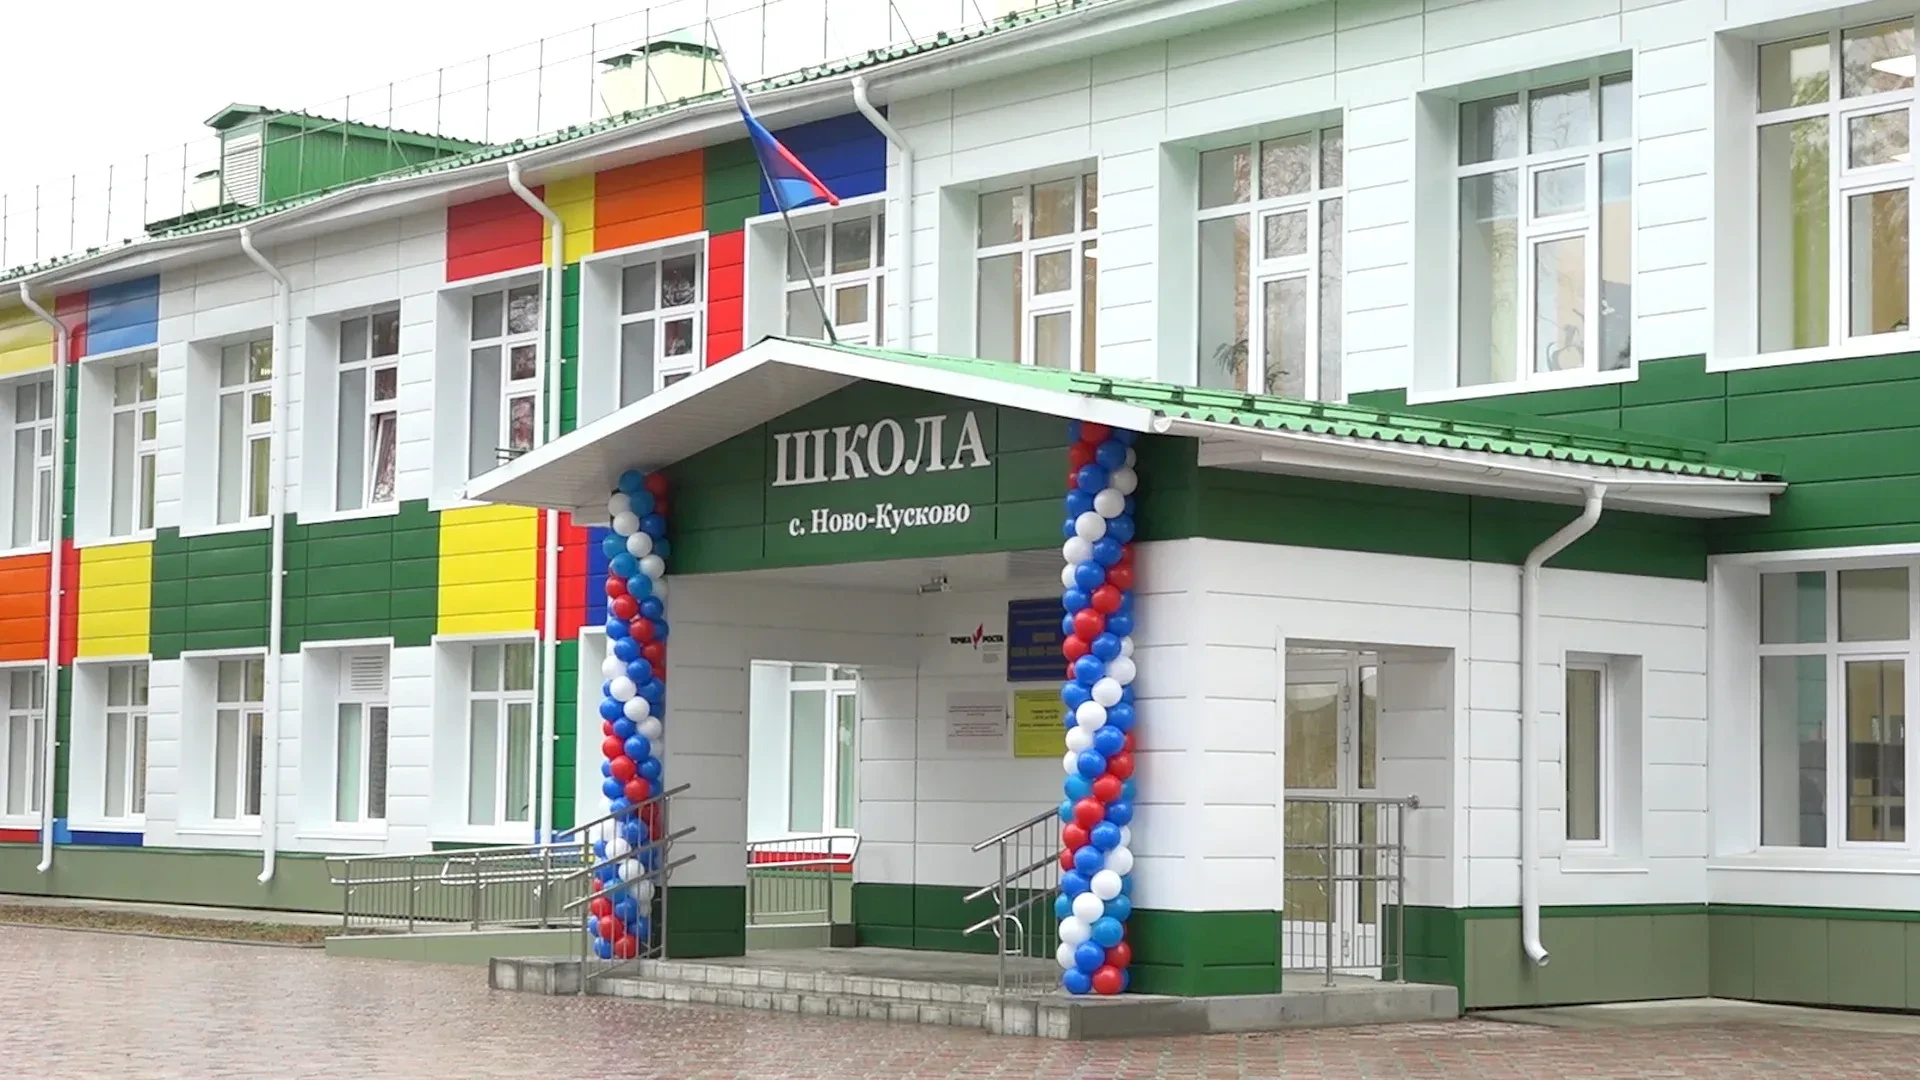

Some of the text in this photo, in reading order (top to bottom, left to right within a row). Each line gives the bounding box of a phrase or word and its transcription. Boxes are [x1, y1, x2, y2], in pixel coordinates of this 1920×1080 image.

[772, 411, 991, 487] ШКОЛА
[789, 503, 970, 536] с. Ново-Кусково
